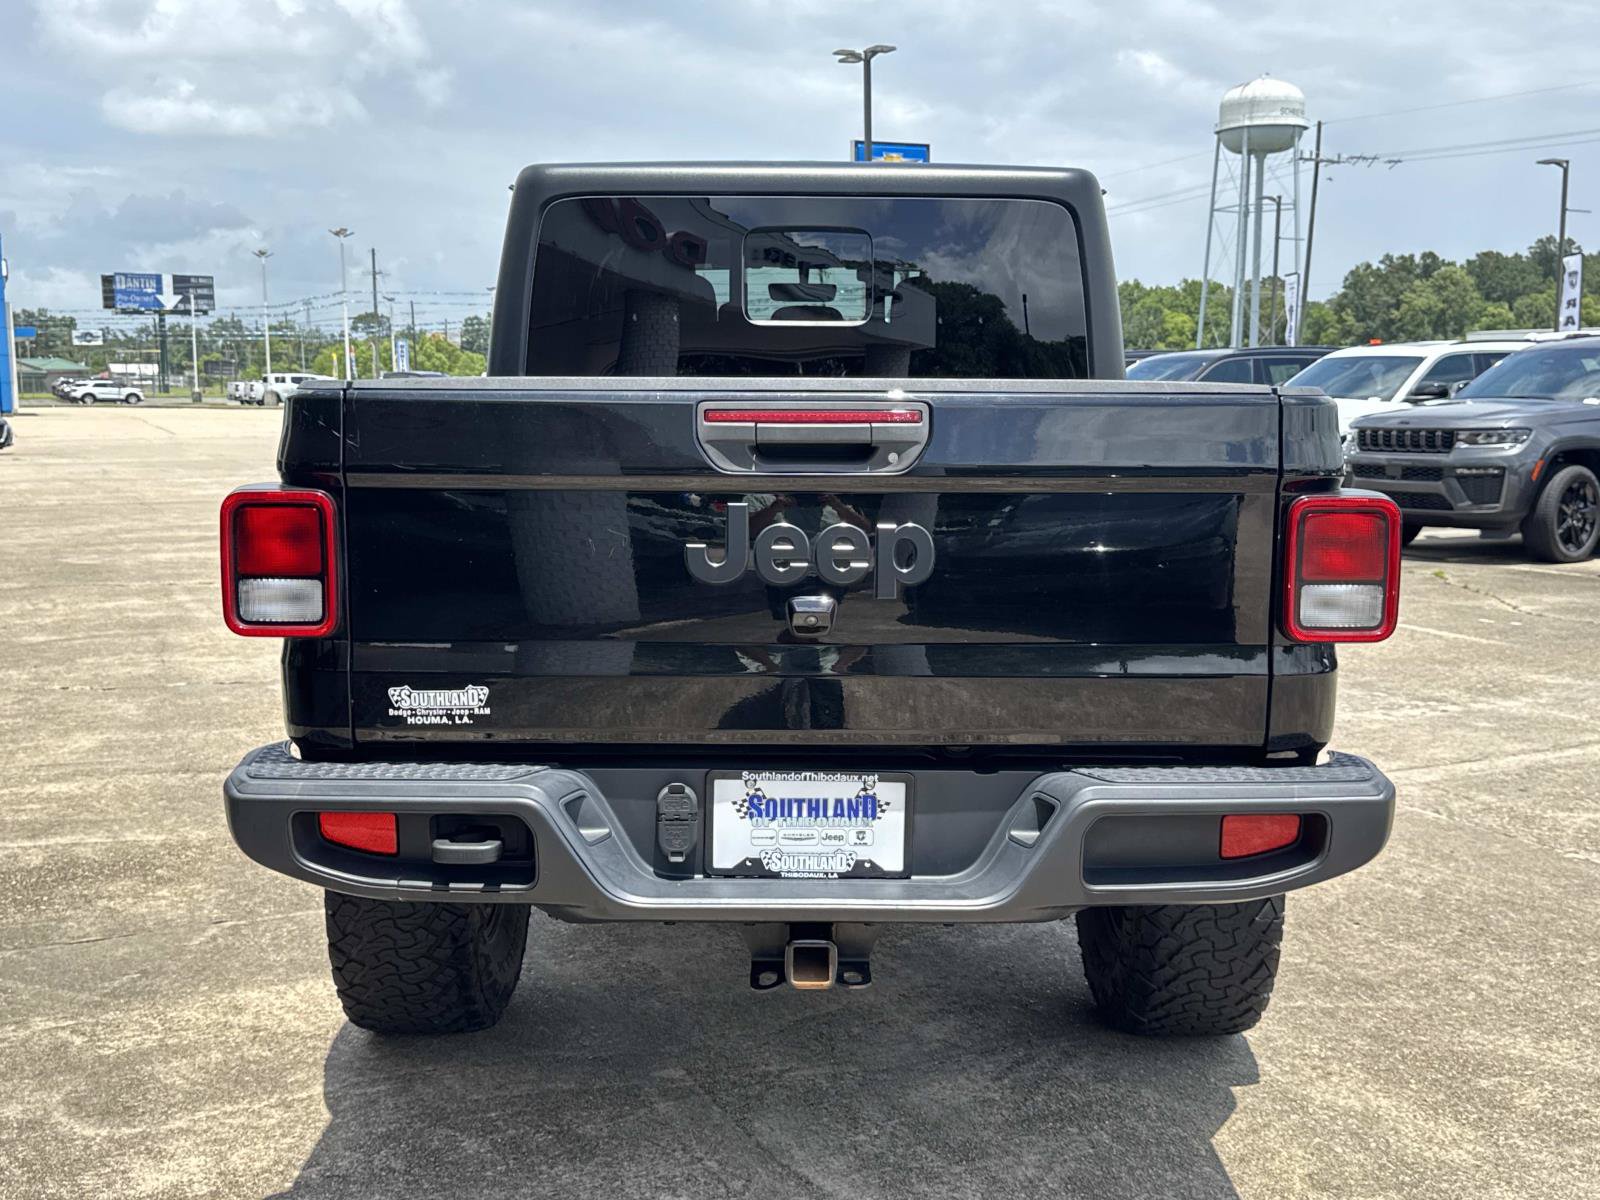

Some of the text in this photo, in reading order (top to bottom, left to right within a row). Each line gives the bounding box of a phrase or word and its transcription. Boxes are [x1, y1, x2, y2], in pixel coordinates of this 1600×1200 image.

[114, 274, 156, 290] DANTIN
[684, 502, 936, 600] Jeep
[400, 688, 479, 707] SOUTHLAND
[389, 707, 491, 717] Dodge Chrysler Jeep RAM
[407, 716, 473, 725] HOUMA, LA.
[741, 771, 879, 782] SouthlandofThibodaux.net
[748, 794, 877, 821] SOUTHLAND
[751, 817, 873, 827] OF THIBODAUX
[822, 833, 844, 842] Jeep
[771, 852, 847, 871] SOUTHLAND
